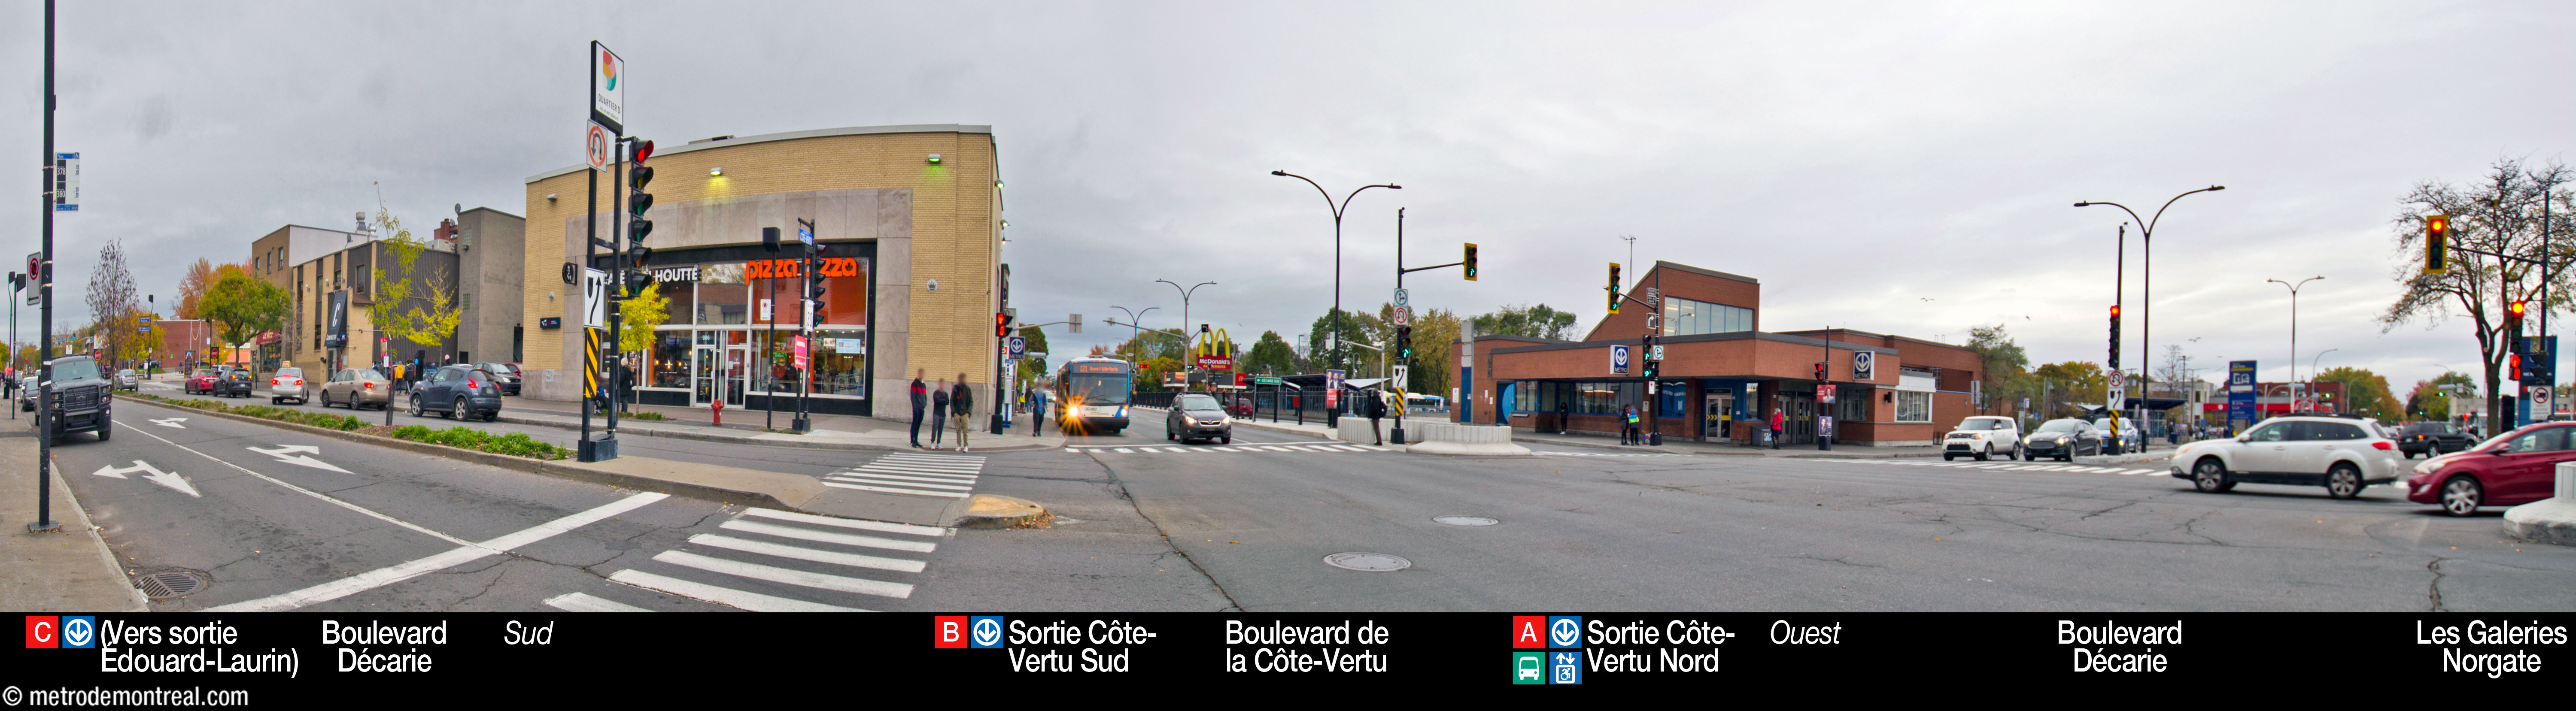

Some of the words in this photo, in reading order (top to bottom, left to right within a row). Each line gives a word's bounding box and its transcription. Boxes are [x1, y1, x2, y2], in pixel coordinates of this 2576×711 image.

[598, 93, 617, 112] QUARTIER
[618, 106, 620, 114] D
[655, 268, 698, 282] HOUTTE
[745, 258, 798, 286] pizza
[805, 257, 857, 277] zza
[605, 270, 625, 285] CAÉ
[332, 303, 340, 327] C
[807, 312, 813, 327] 30
